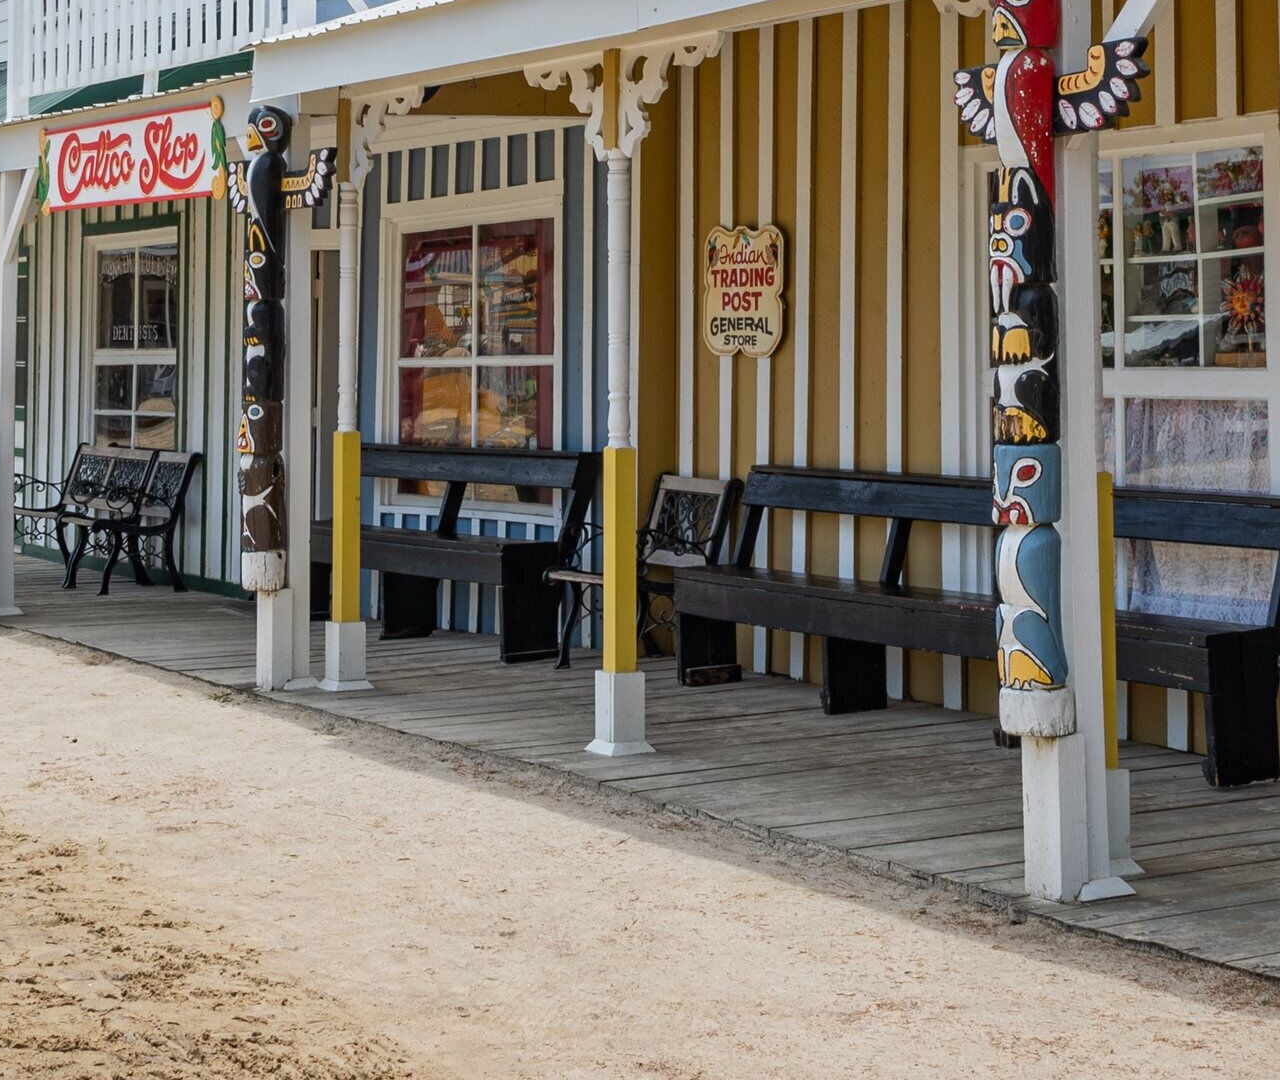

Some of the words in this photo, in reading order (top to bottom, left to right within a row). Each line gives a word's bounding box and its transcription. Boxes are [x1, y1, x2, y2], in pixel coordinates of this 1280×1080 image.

[57, 128, 135, 204] Calico
[139, 116, 206, 196] Shop
[719, 243, 768, 265] Indian
[710, 267, 775, 288] TRADING
[722, 291, 762, 312] POST
[113, 324, 158, 341] DENTISTS
[710, 316, 773, 336] GENERAL
[723, 334, 757, 346] STORE
